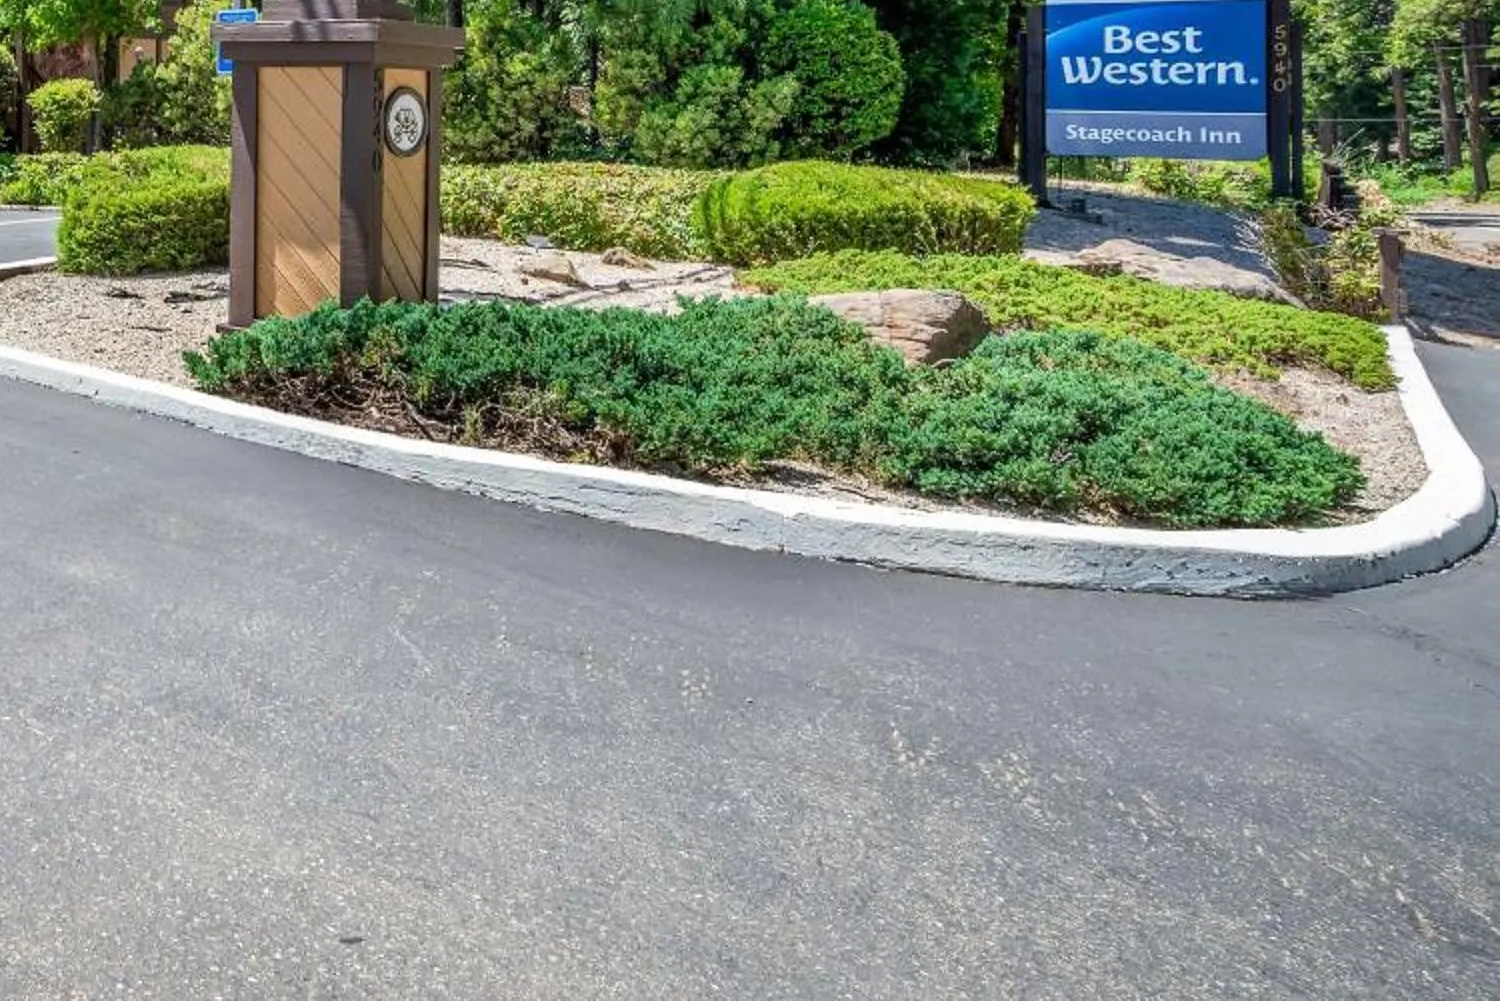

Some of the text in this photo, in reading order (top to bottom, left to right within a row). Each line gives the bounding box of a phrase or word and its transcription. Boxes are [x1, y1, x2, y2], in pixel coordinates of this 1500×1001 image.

[1104, 25, 1203, 54] Best
[1065, 124, 1243, 145] Stagecoach Inn
